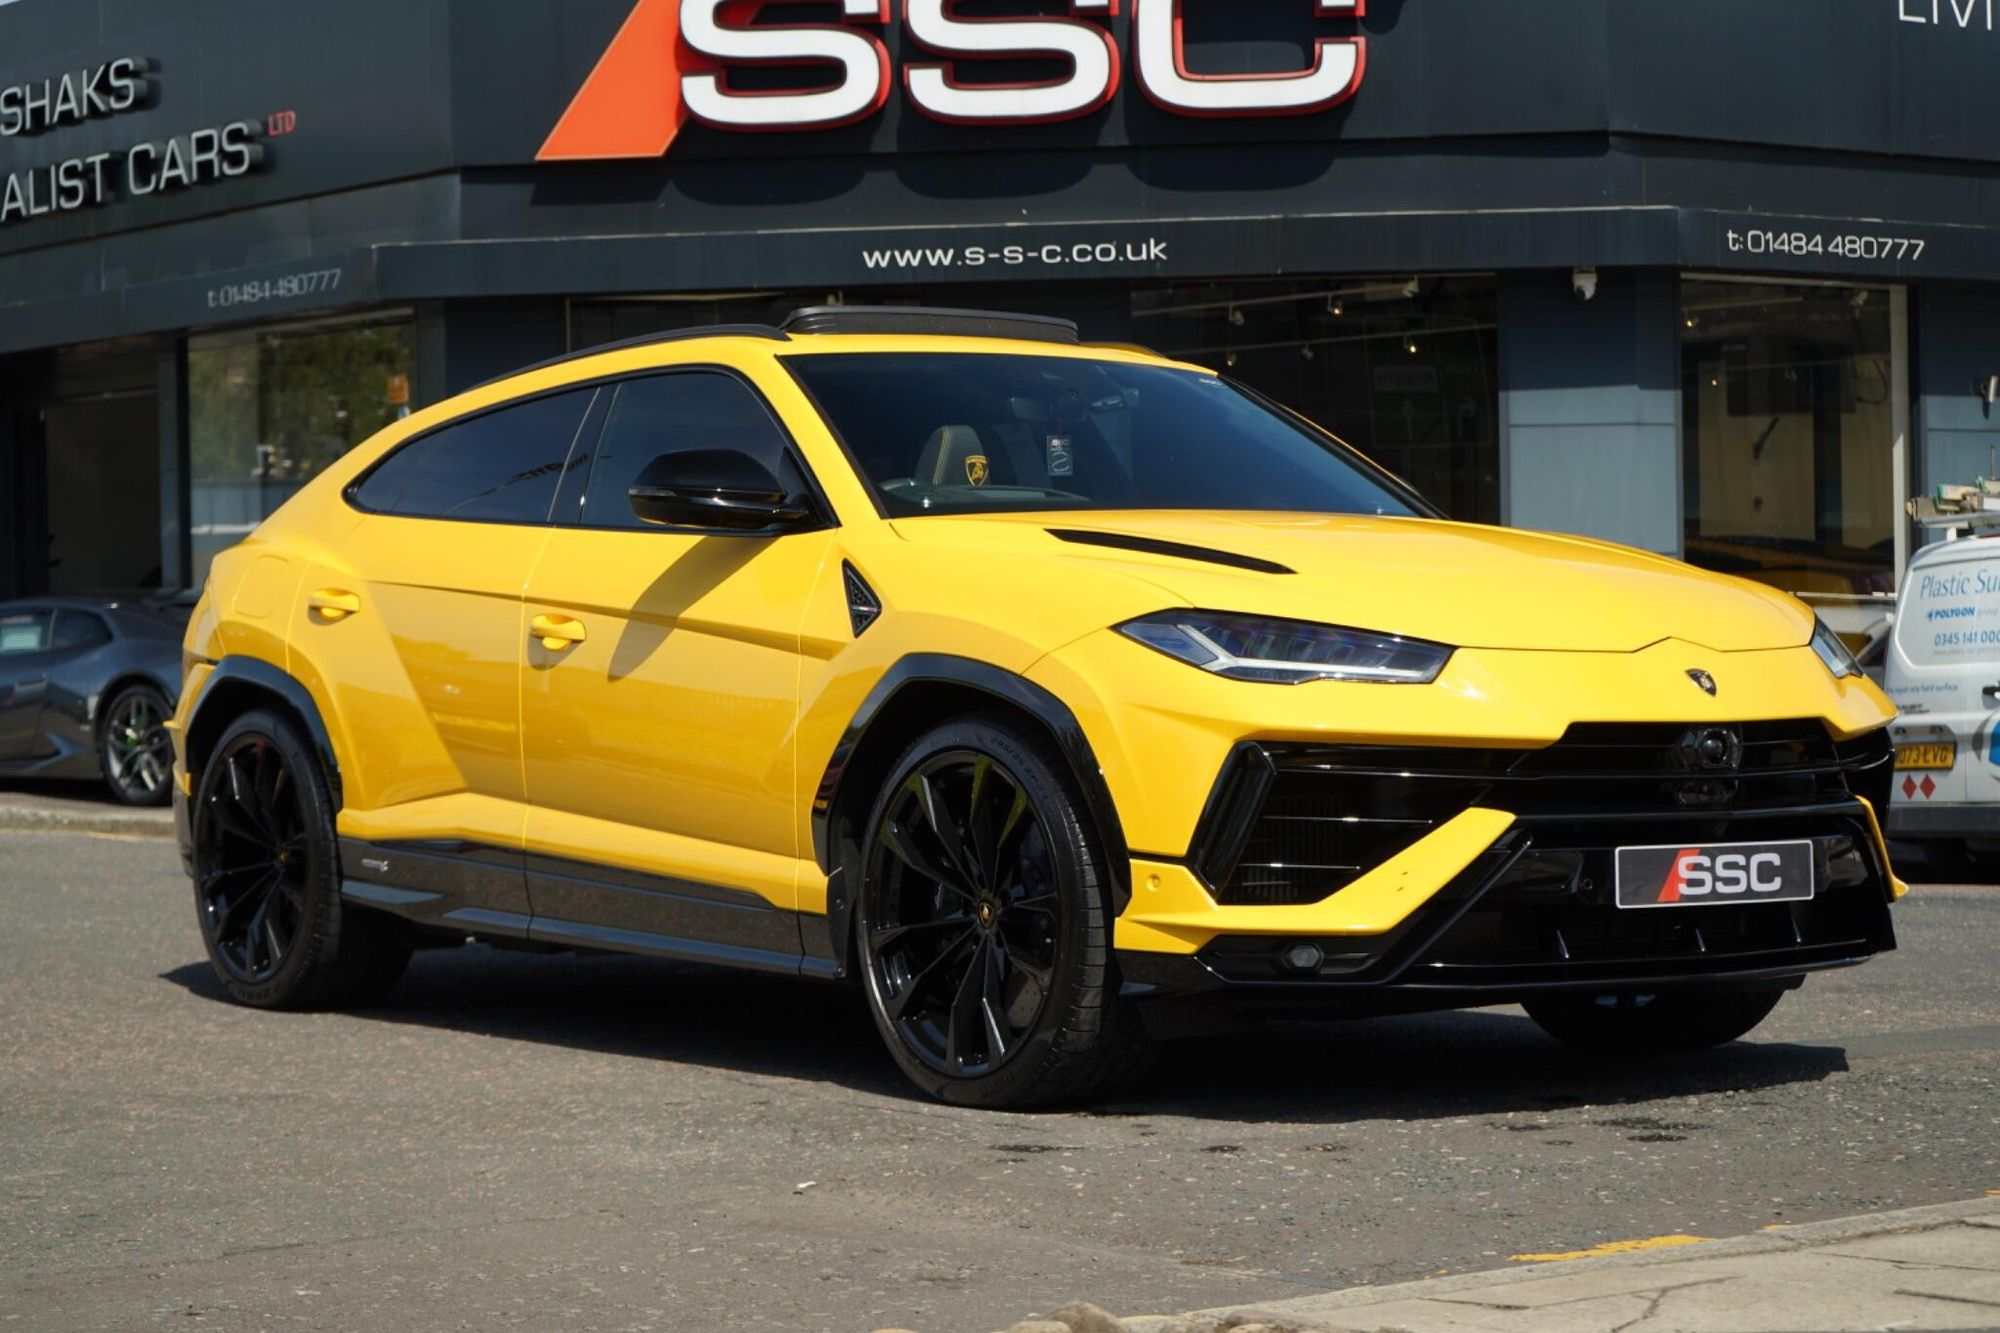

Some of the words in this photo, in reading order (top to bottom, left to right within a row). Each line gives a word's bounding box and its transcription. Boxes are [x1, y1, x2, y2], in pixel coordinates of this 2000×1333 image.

[679, 0, 1366, 128] SSC
[0, 57, 136, 136] SHAKS
[0, 153, 110, 222] ALIST
[128, 122, 252, 196] CARS
[267, 110, 296, 137] LTD
[862, 238, 1168, 269] www.s-s-c.co.uk
[1920, 571, 1970, 599] Plastic
[1933, 605, 1976, 619] POLYGON
[1934, 632, 1959, 647] 0345
[1962, 630, 1978, 645] 141
[1678, 852, 1782, 896] SSC
